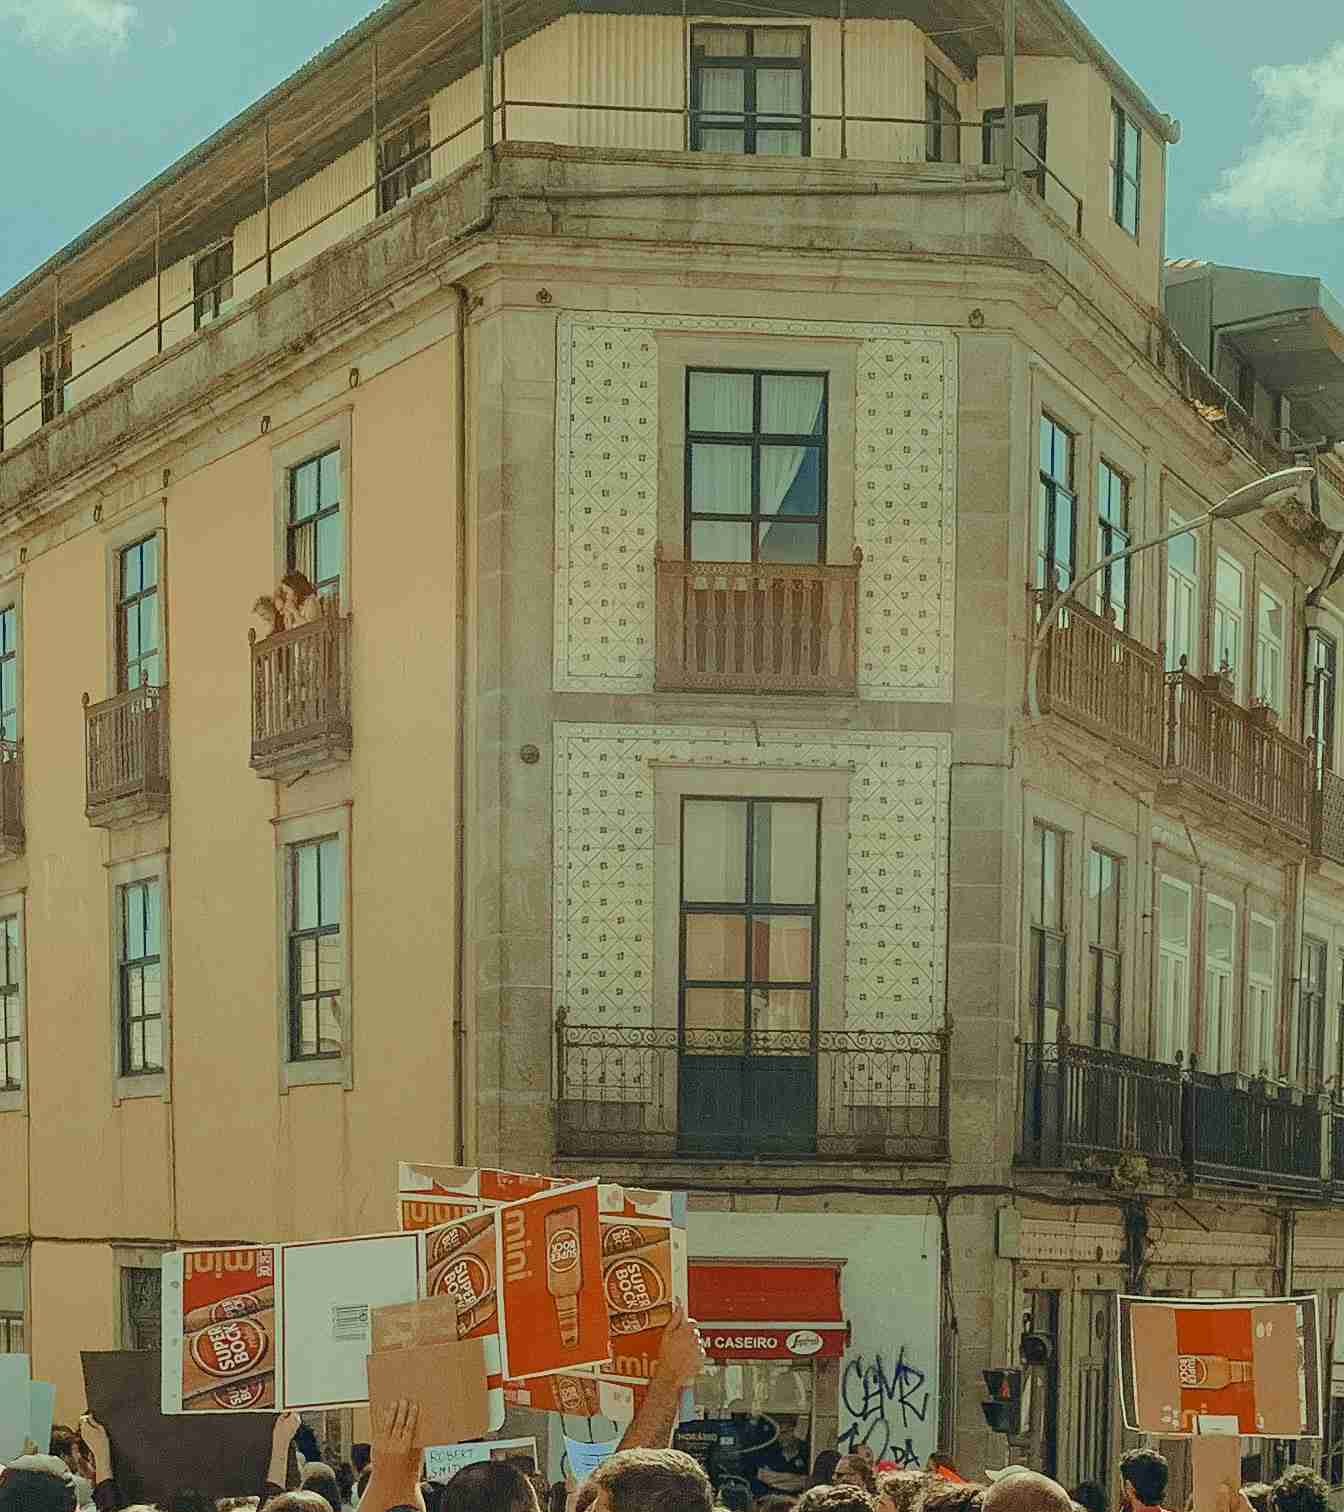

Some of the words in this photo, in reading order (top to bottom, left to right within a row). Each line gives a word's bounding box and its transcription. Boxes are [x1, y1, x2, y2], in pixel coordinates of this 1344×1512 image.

[185, 1250, 256, 1281] mini
[627, 1263, 652, 1308] SUPER
[615, 1268, 638, 1309] BOCK
[208, 1325, 235, 1371] SUPER
[227, 1322, 251, 1365] BOCK
[714, 1336, 778, 1350] CASEIRO
